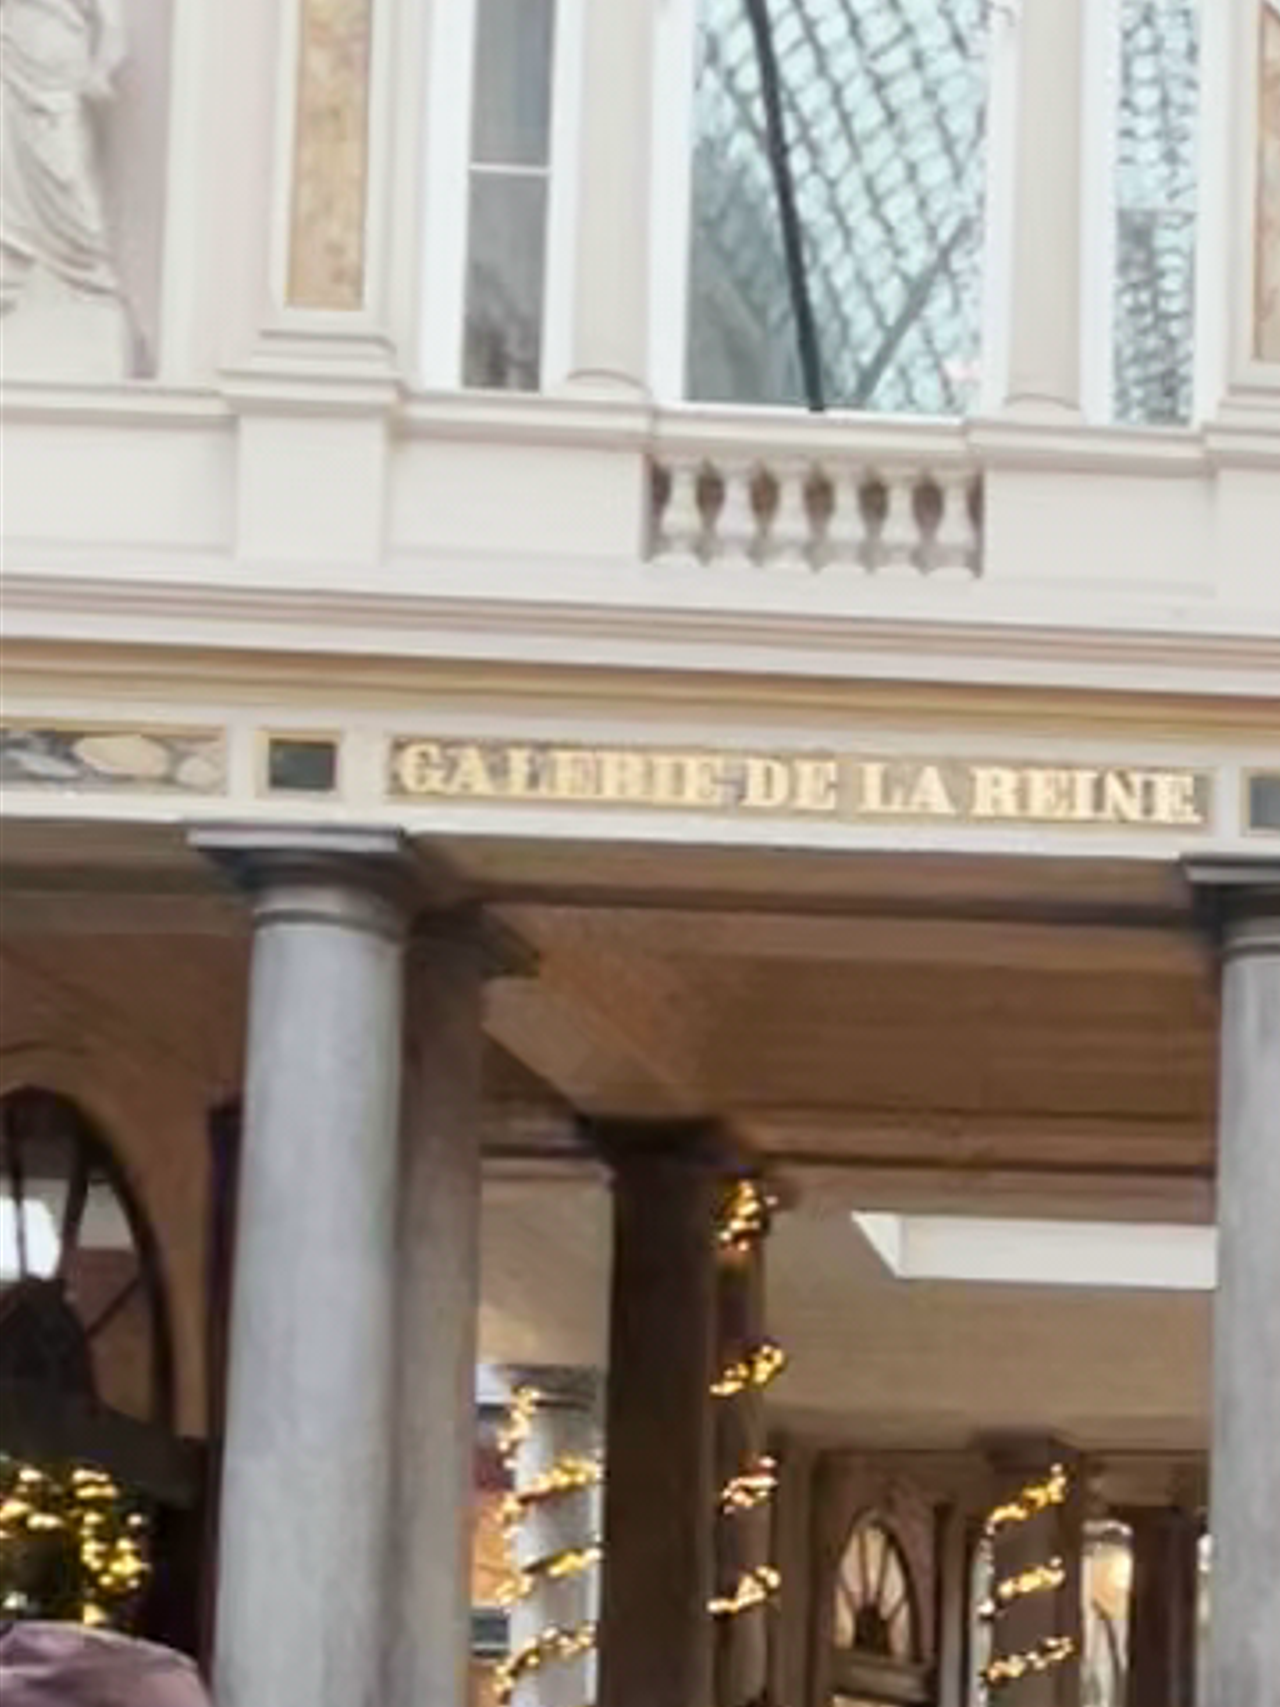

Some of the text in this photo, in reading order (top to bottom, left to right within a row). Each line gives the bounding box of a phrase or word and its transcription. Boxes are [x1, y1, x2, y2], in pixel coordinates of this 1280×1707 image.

[400, 742, 723, 808] GALERIE
[739, 754, 838, 811] DE
[856, 761, 957, 816] LA
